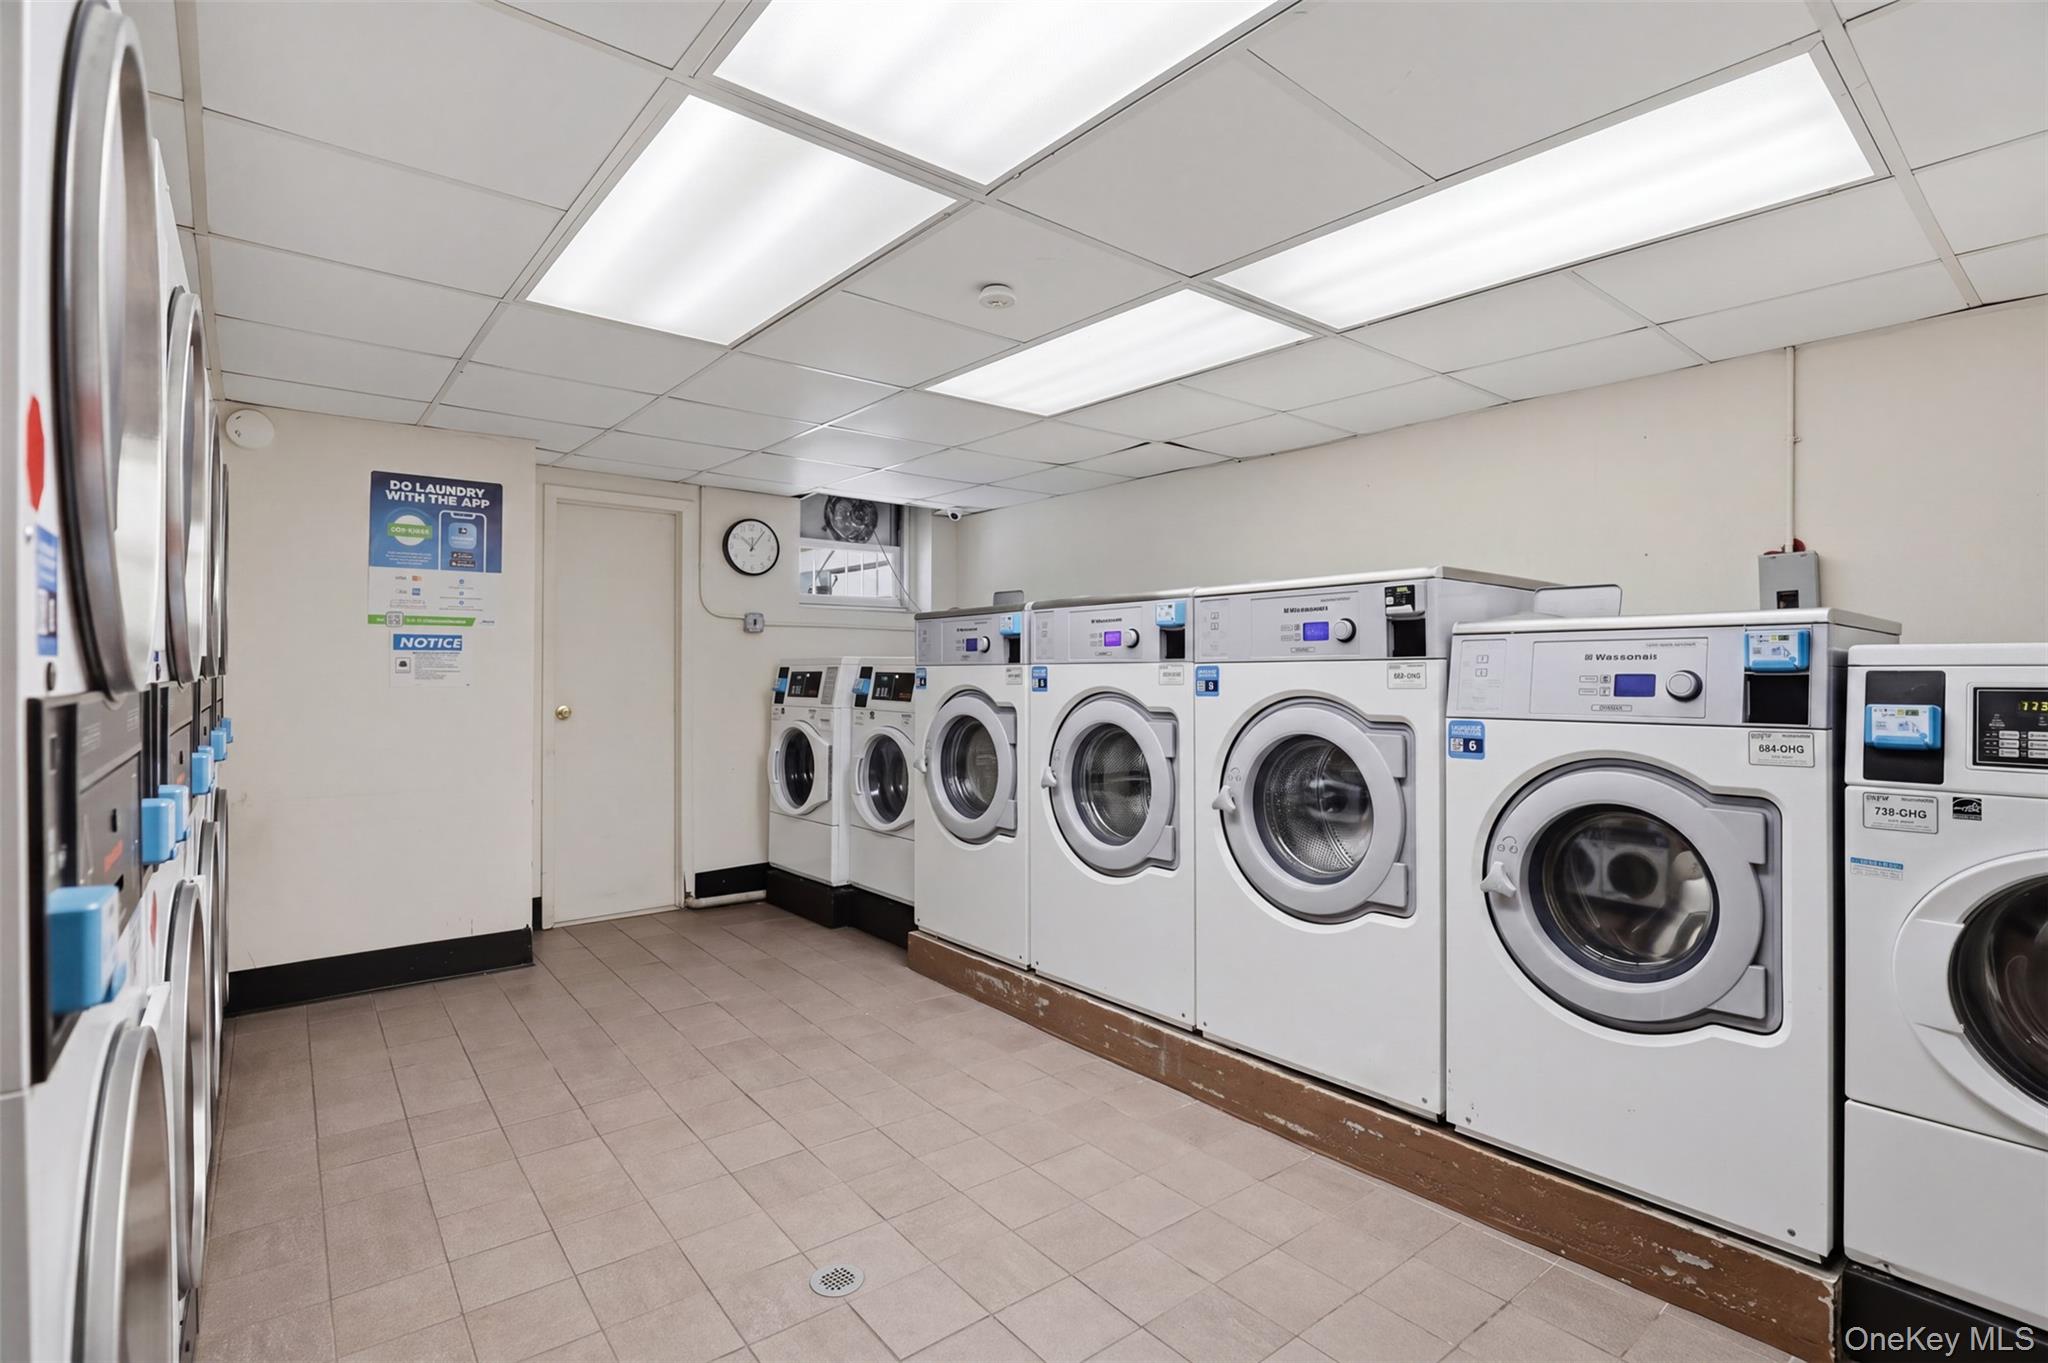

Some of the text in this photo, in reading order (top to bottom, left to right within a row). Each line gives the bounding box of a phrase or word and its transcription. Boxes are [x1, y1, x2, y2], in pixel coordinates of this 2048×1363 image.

[390, 479, 485, 498] DO LAUNDRY
[385, 489, 490, 508] WITH THE APP
[399, 637, 462, 649] NOTICE
[1468, 740, 1477, 751] 6
